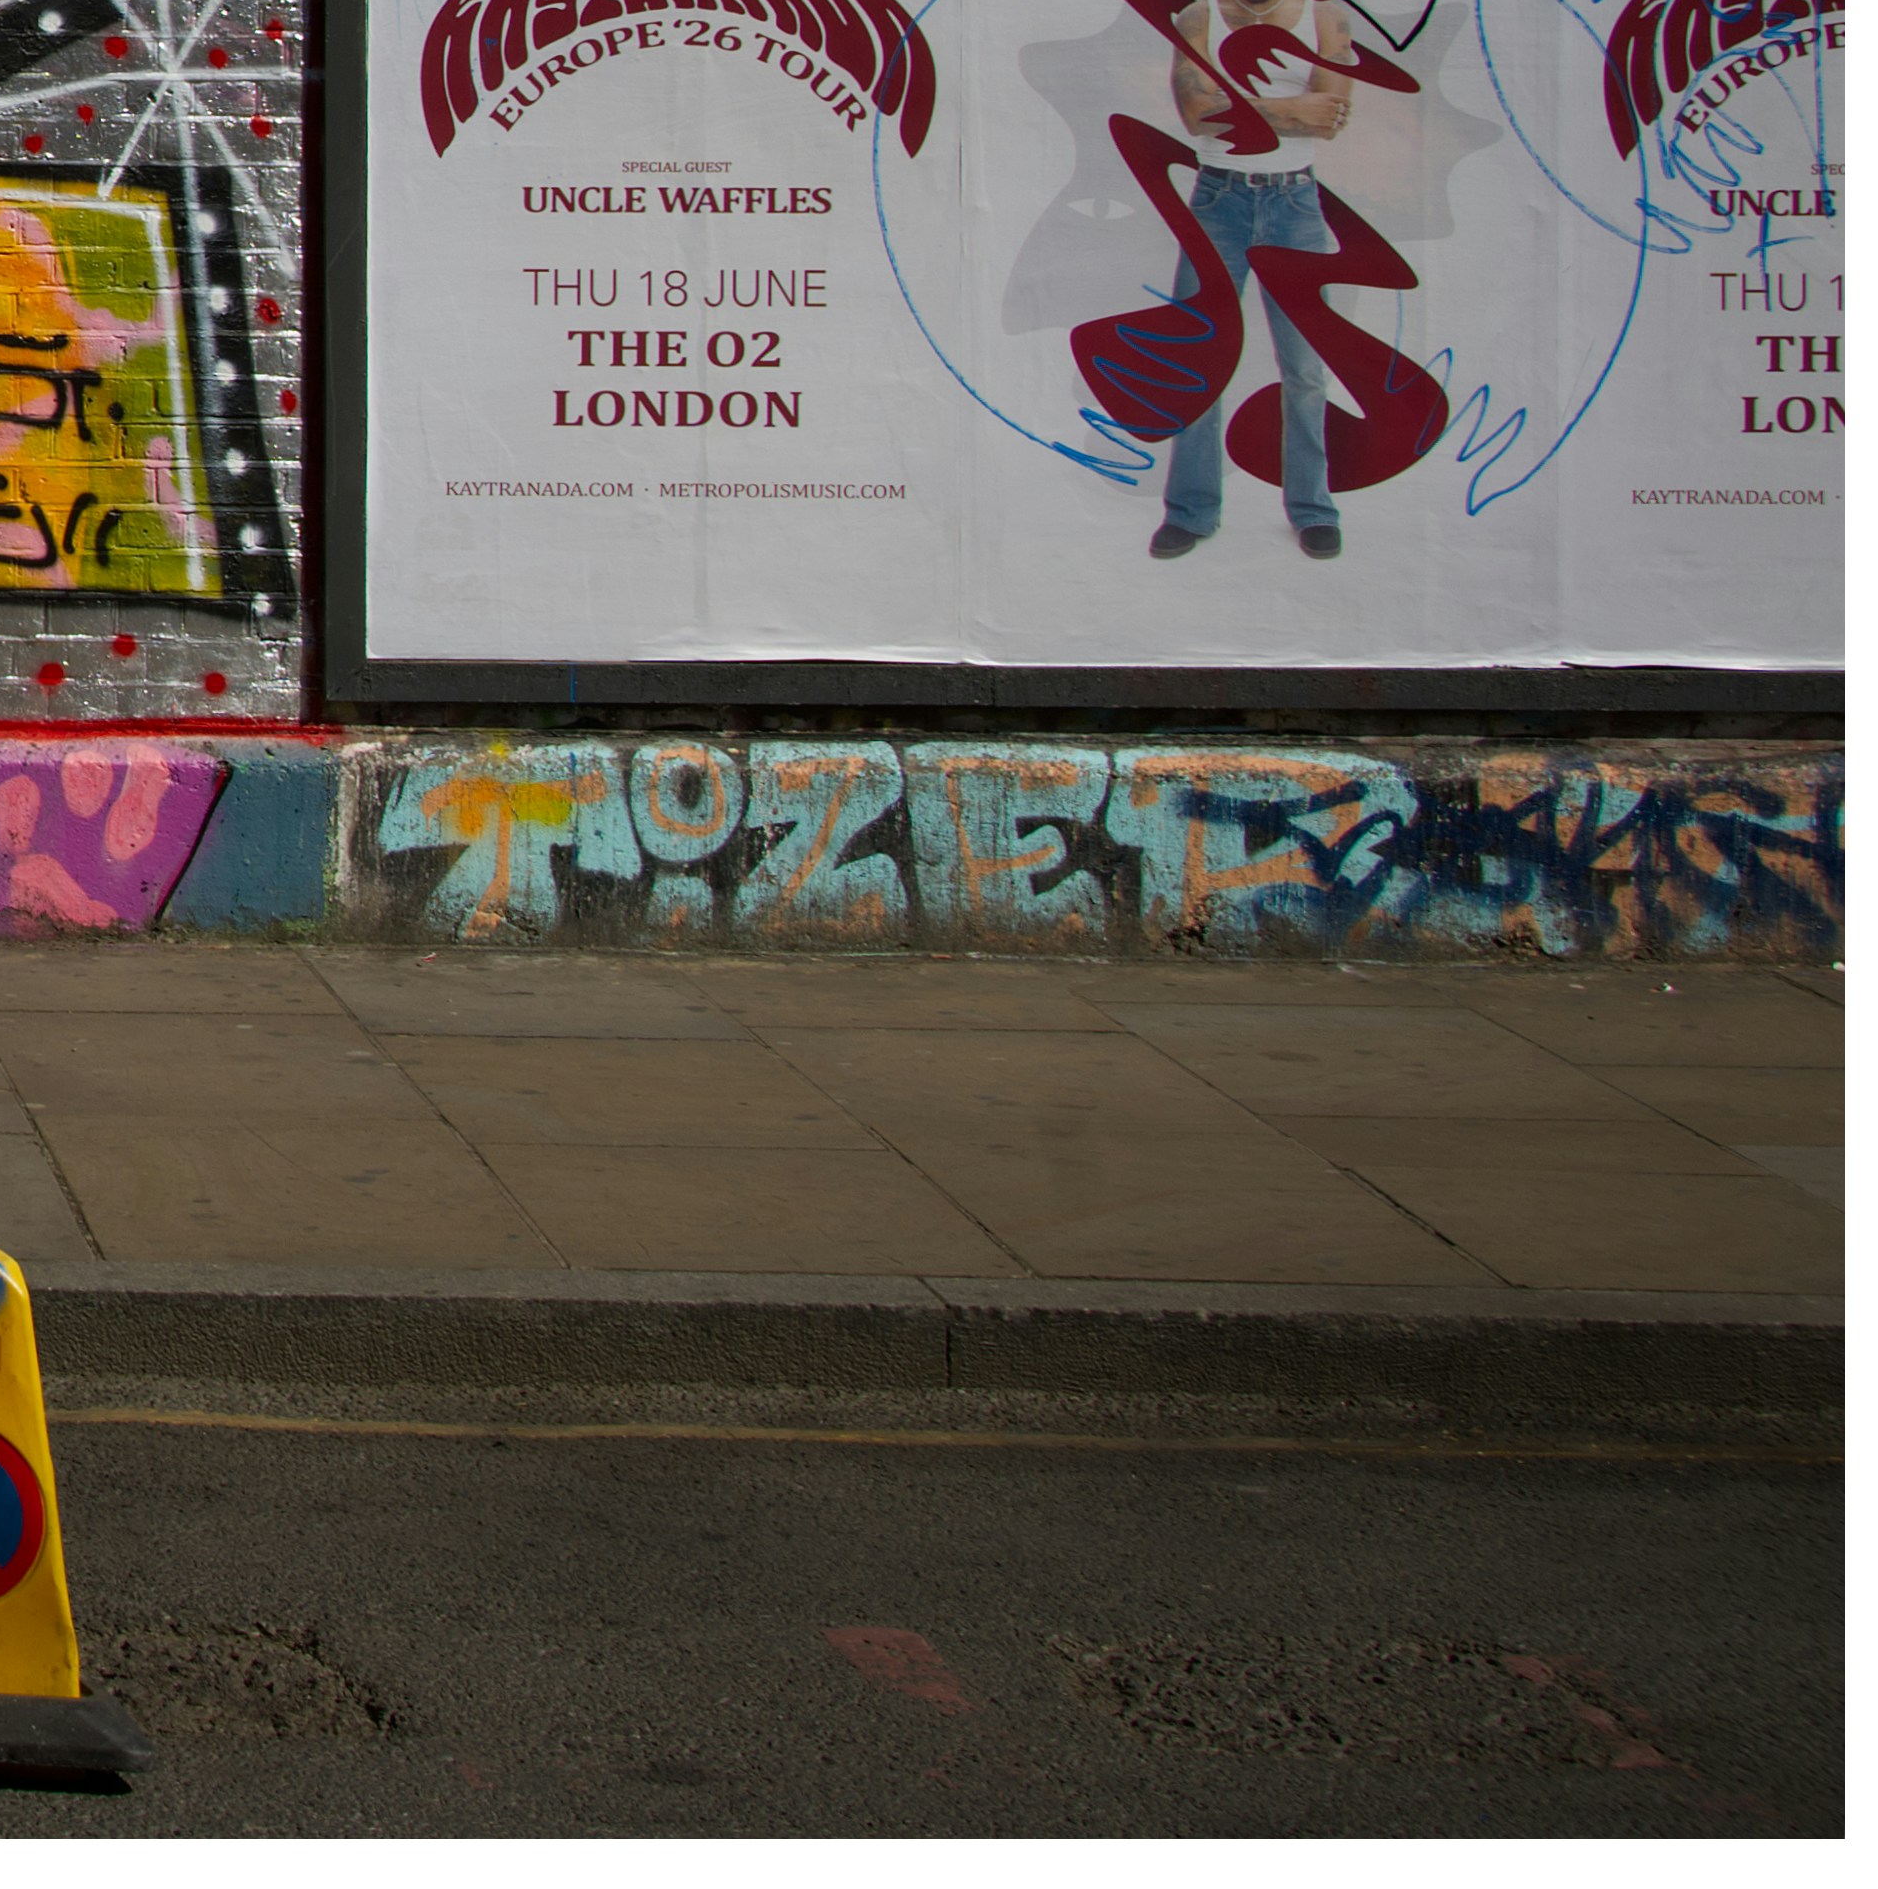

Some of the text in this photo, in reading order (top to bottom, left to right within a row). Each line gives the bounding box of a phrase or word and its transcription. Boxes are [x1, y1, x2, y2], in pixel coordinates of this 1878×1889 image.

[488, 21, 665, 132] EUROPE
[753, 32, 868, 131] TOUR
[1673, 21, 1845, 134] EUROPE
[622, 160, 732, 174] SPECIAL GUEST
[523, 186, 833, 214] UNCLE WAFFLES
[1709, 190, 1837, 216] UNCLE
[523, 268, 828, 308] THU 18 JUNE
[1709, 273, 1806, 312] THU
[568, 329, 782, 368] THE O2
[552, 389, 803, 428] LONDON
[444, 479, 907, 501] KAYTRANADA.COM METROPOLISMUSIC.COM
[1631, 489, 1826, 505] KAYTRANADA.COM
